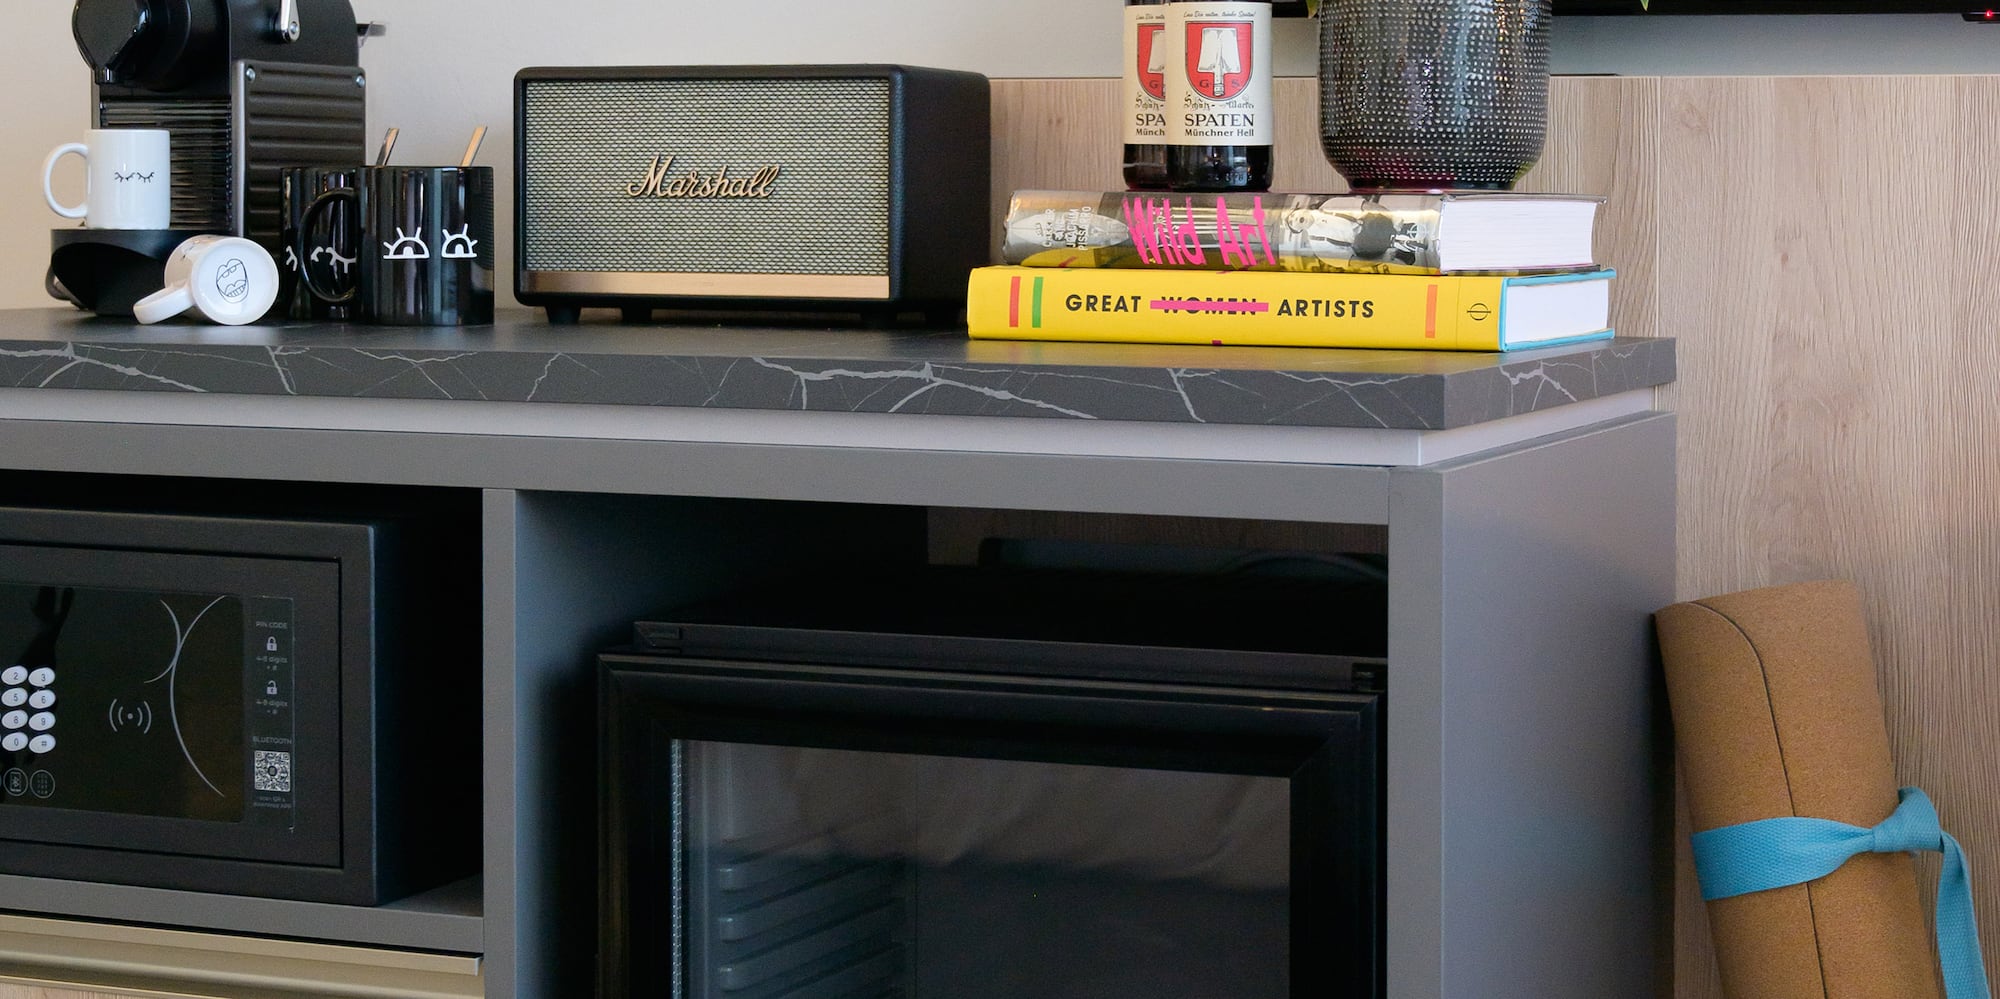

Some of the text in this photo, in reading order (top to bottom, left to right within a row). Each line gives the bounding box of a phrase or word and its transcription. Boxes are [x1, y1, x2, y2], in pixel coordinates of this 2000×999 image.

[1199, 79, 1209, 89] G
[1184, 113, 1255, 127] SPATEN
[1184, 128, 1254, 137] Münchner Hell
[627, 153, 780, 198] Marshall
[1078, 206, 1091, 250] PISSARRO
[1123, 196, 1276, 265] Wild Art
[1065, 294, 1142, 313] GREAT
[1277, 298, 1375, 318] ARTISTS
